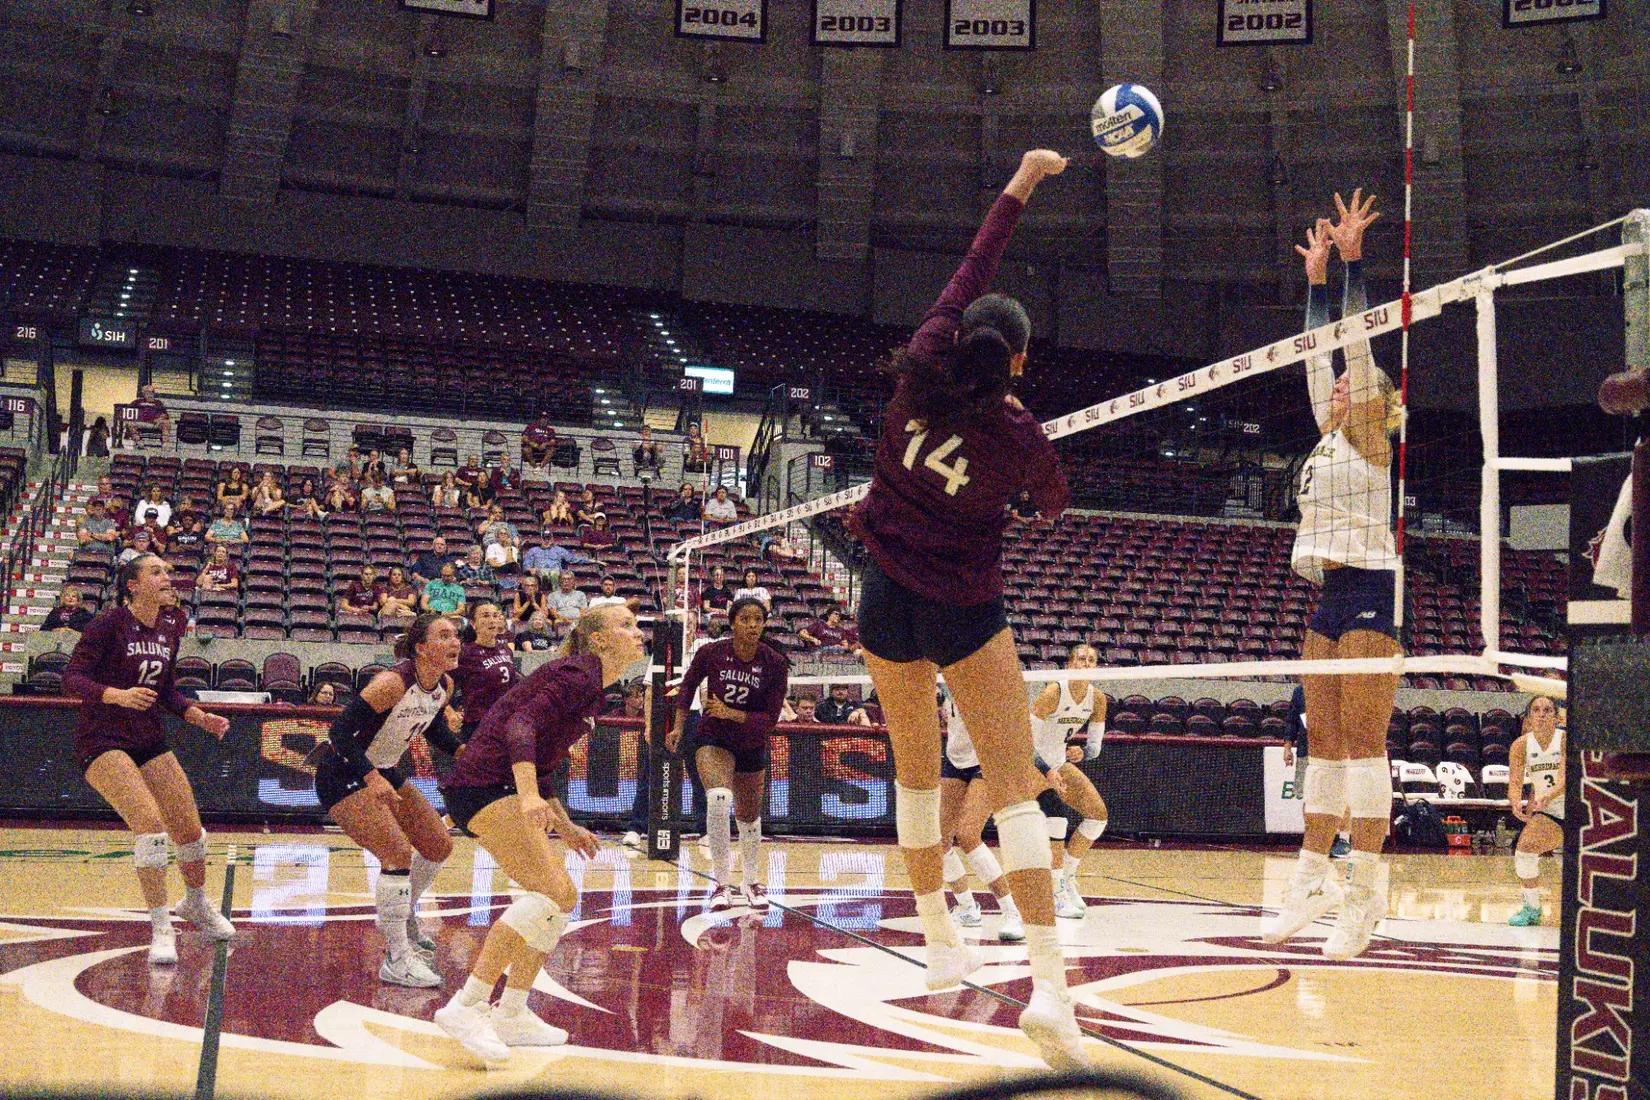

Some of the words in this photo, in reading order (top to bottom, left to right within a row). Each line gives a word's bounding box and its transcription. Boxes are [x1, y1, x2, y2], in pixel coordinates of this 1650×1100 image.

[684, 8, 758, 28] 2004
[821, 15, 891, 33] 2003
[1228, 13, 1302, 31] 2002
[954, 19, 1026, 36] 2003
[1095, 111, 1132, 133] molten
[1364, 308, 1388, 330] SIU
[16, 326, 37, 339] 216
[104, 330, 125, 342] SIH
[149, 337, 168, 350] 201
[1294, 334, 1316, 354] SIU
[1232, 356, 1251, 374] SIU
[680, 378, 697, 390] 201
[1178, 373, 1196, 391] SIU
[790, 387, 809, 399] 202
[1129, 391, 1145, 408] SIU
[8, 399, 26, 412] 116
[122, 407, 139, 420] 101
[1085, 408, 1099, 423] SIU
[1045, 422, 1058, 435] SIU
[1243, 422, 1260, 434] 202
[719, 448, 734, 460] 101
[814, 455, 831, 467] 102
[902, 419, 970, 496] 14
[1404, 496, 1416, 507] 03
[127, 642, 171, 658] SALUKIS
[137, 660, 163, 684] 12
[499, 666, 510, 683] 3
[719, 669, 760, 689] SALUKIS
[723, 684, 750, 705] 22
[661, 761, 671, 788] sports
